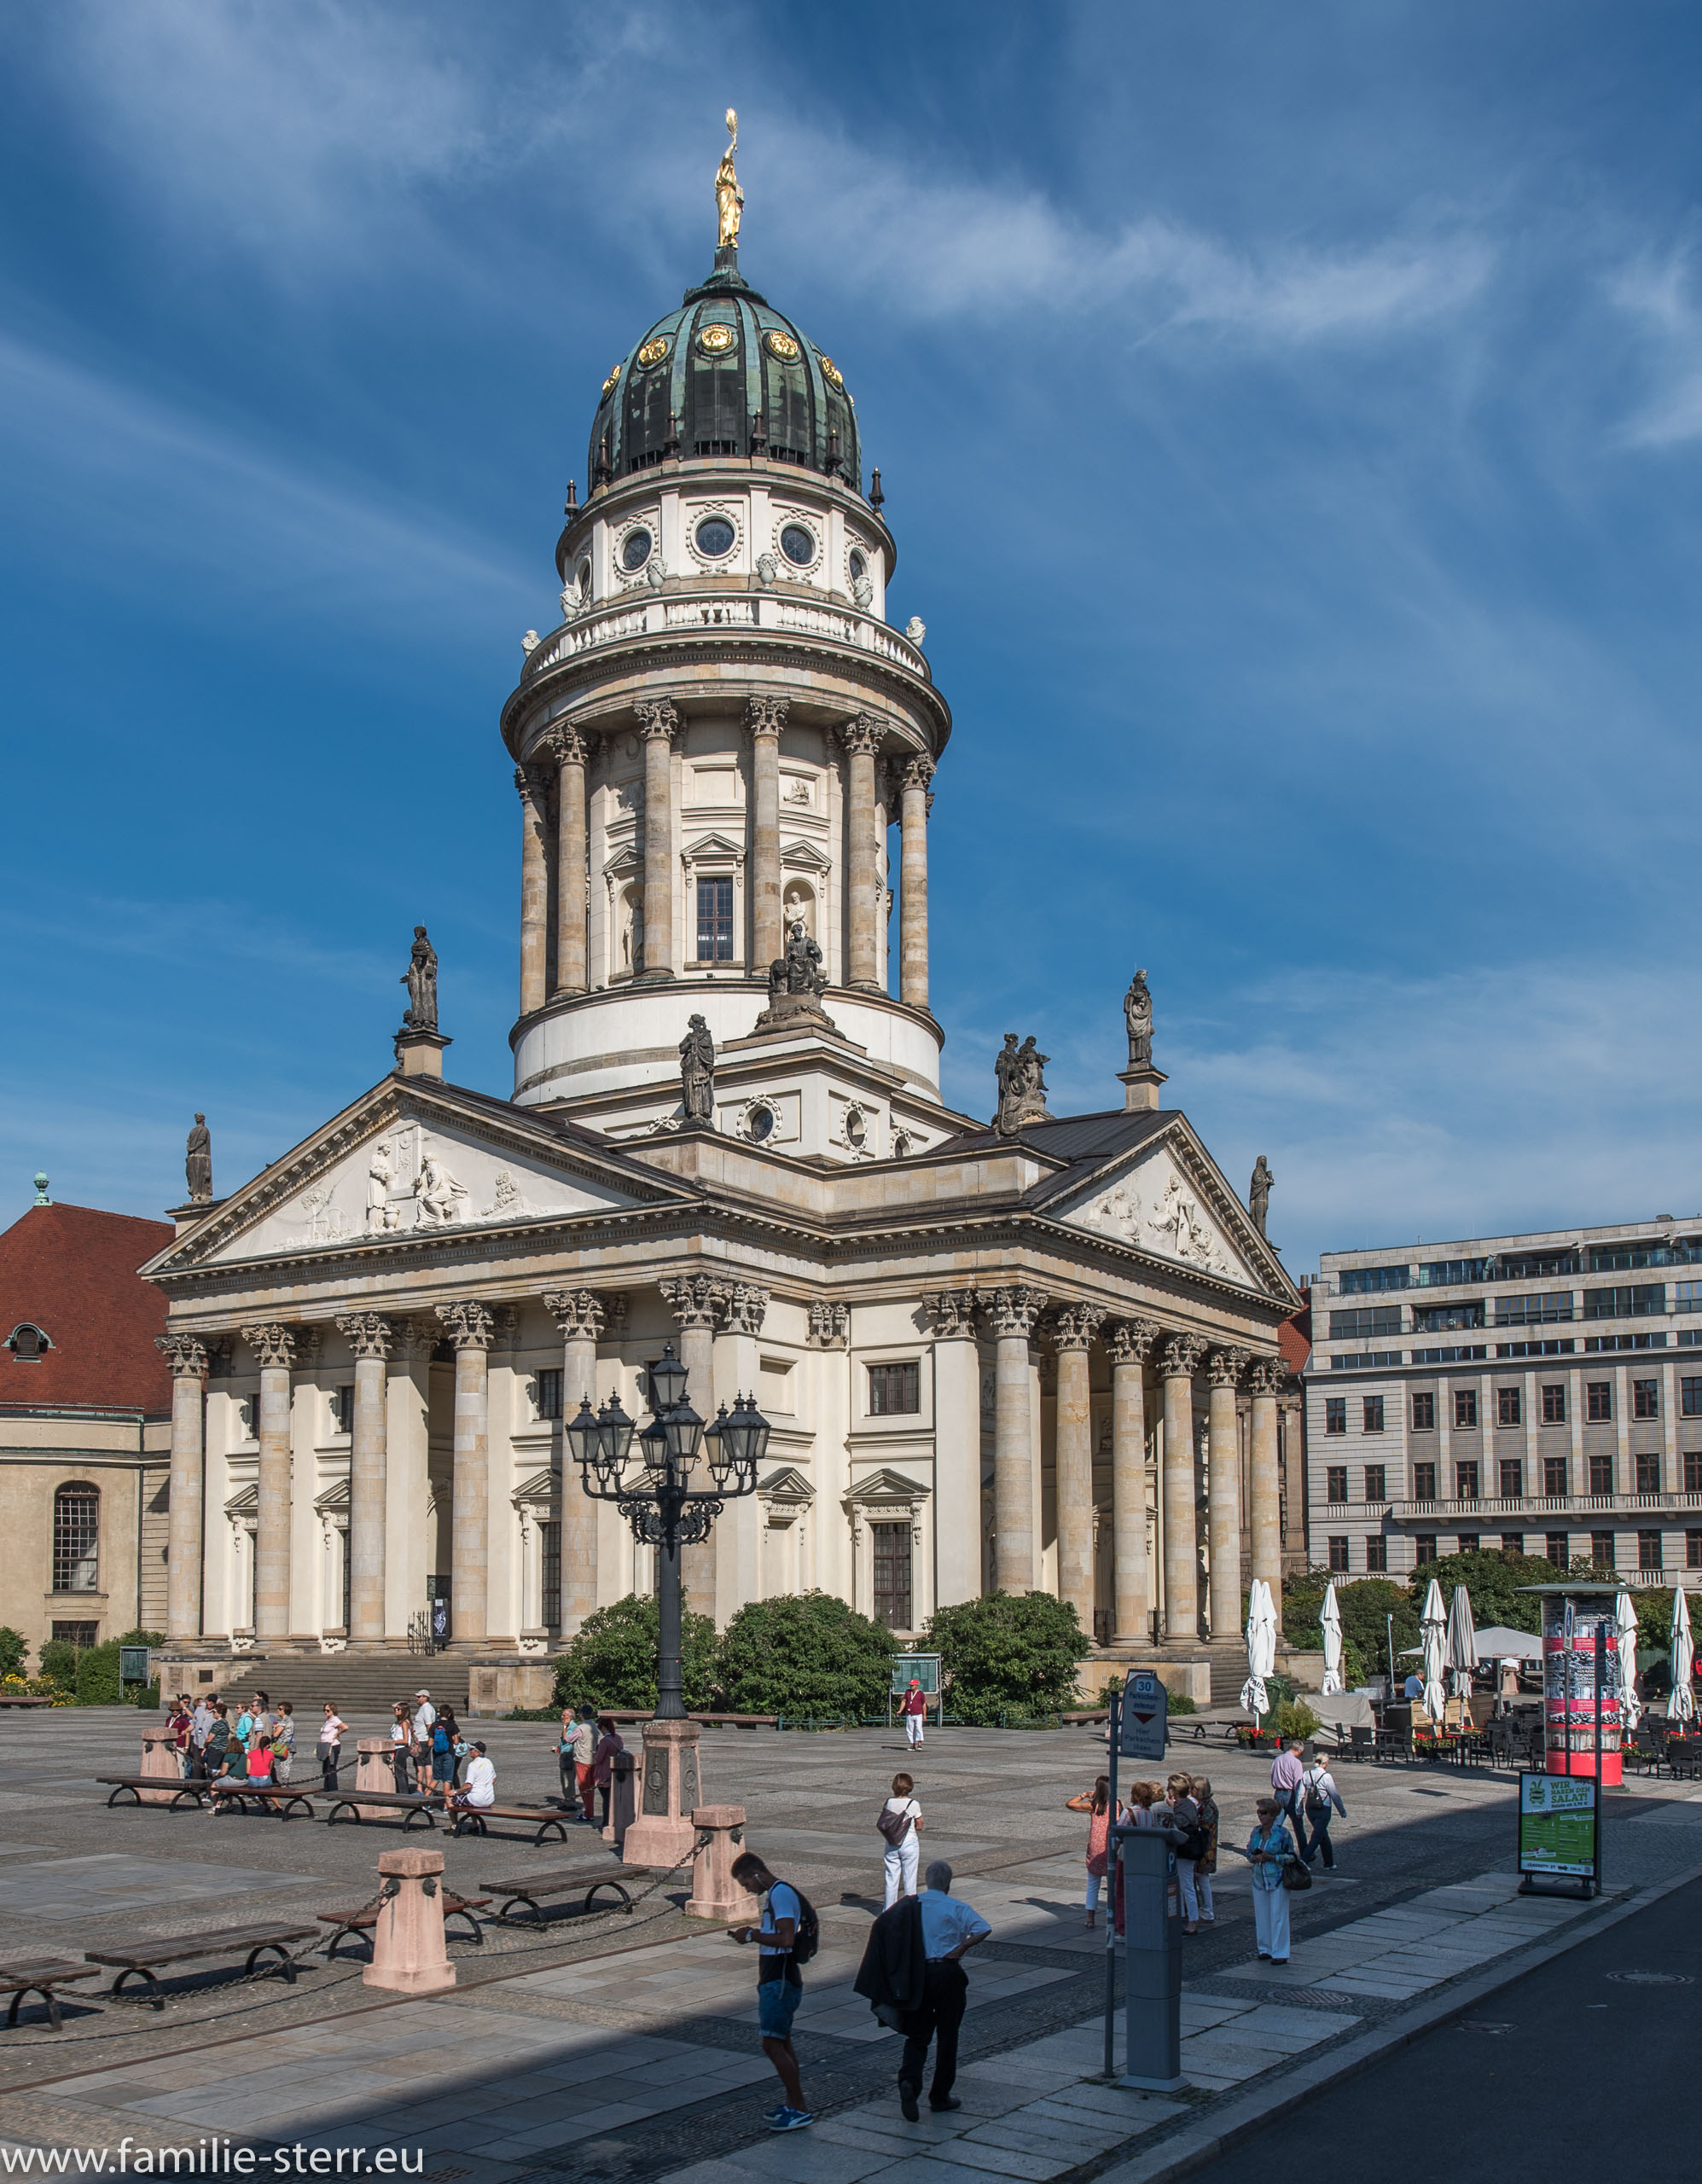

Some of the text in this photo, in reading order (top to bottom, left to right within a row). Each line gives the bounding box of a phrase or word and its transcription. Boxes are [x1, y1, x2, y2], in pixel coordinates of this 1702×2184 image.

[1138, 1682, 1152, 1692] 30
[1550, 1780, 1571, 1789] WIR
[1551, 1793, 1588, 1804] SALAT!
[1168, 1852, 1175, 1873] P
